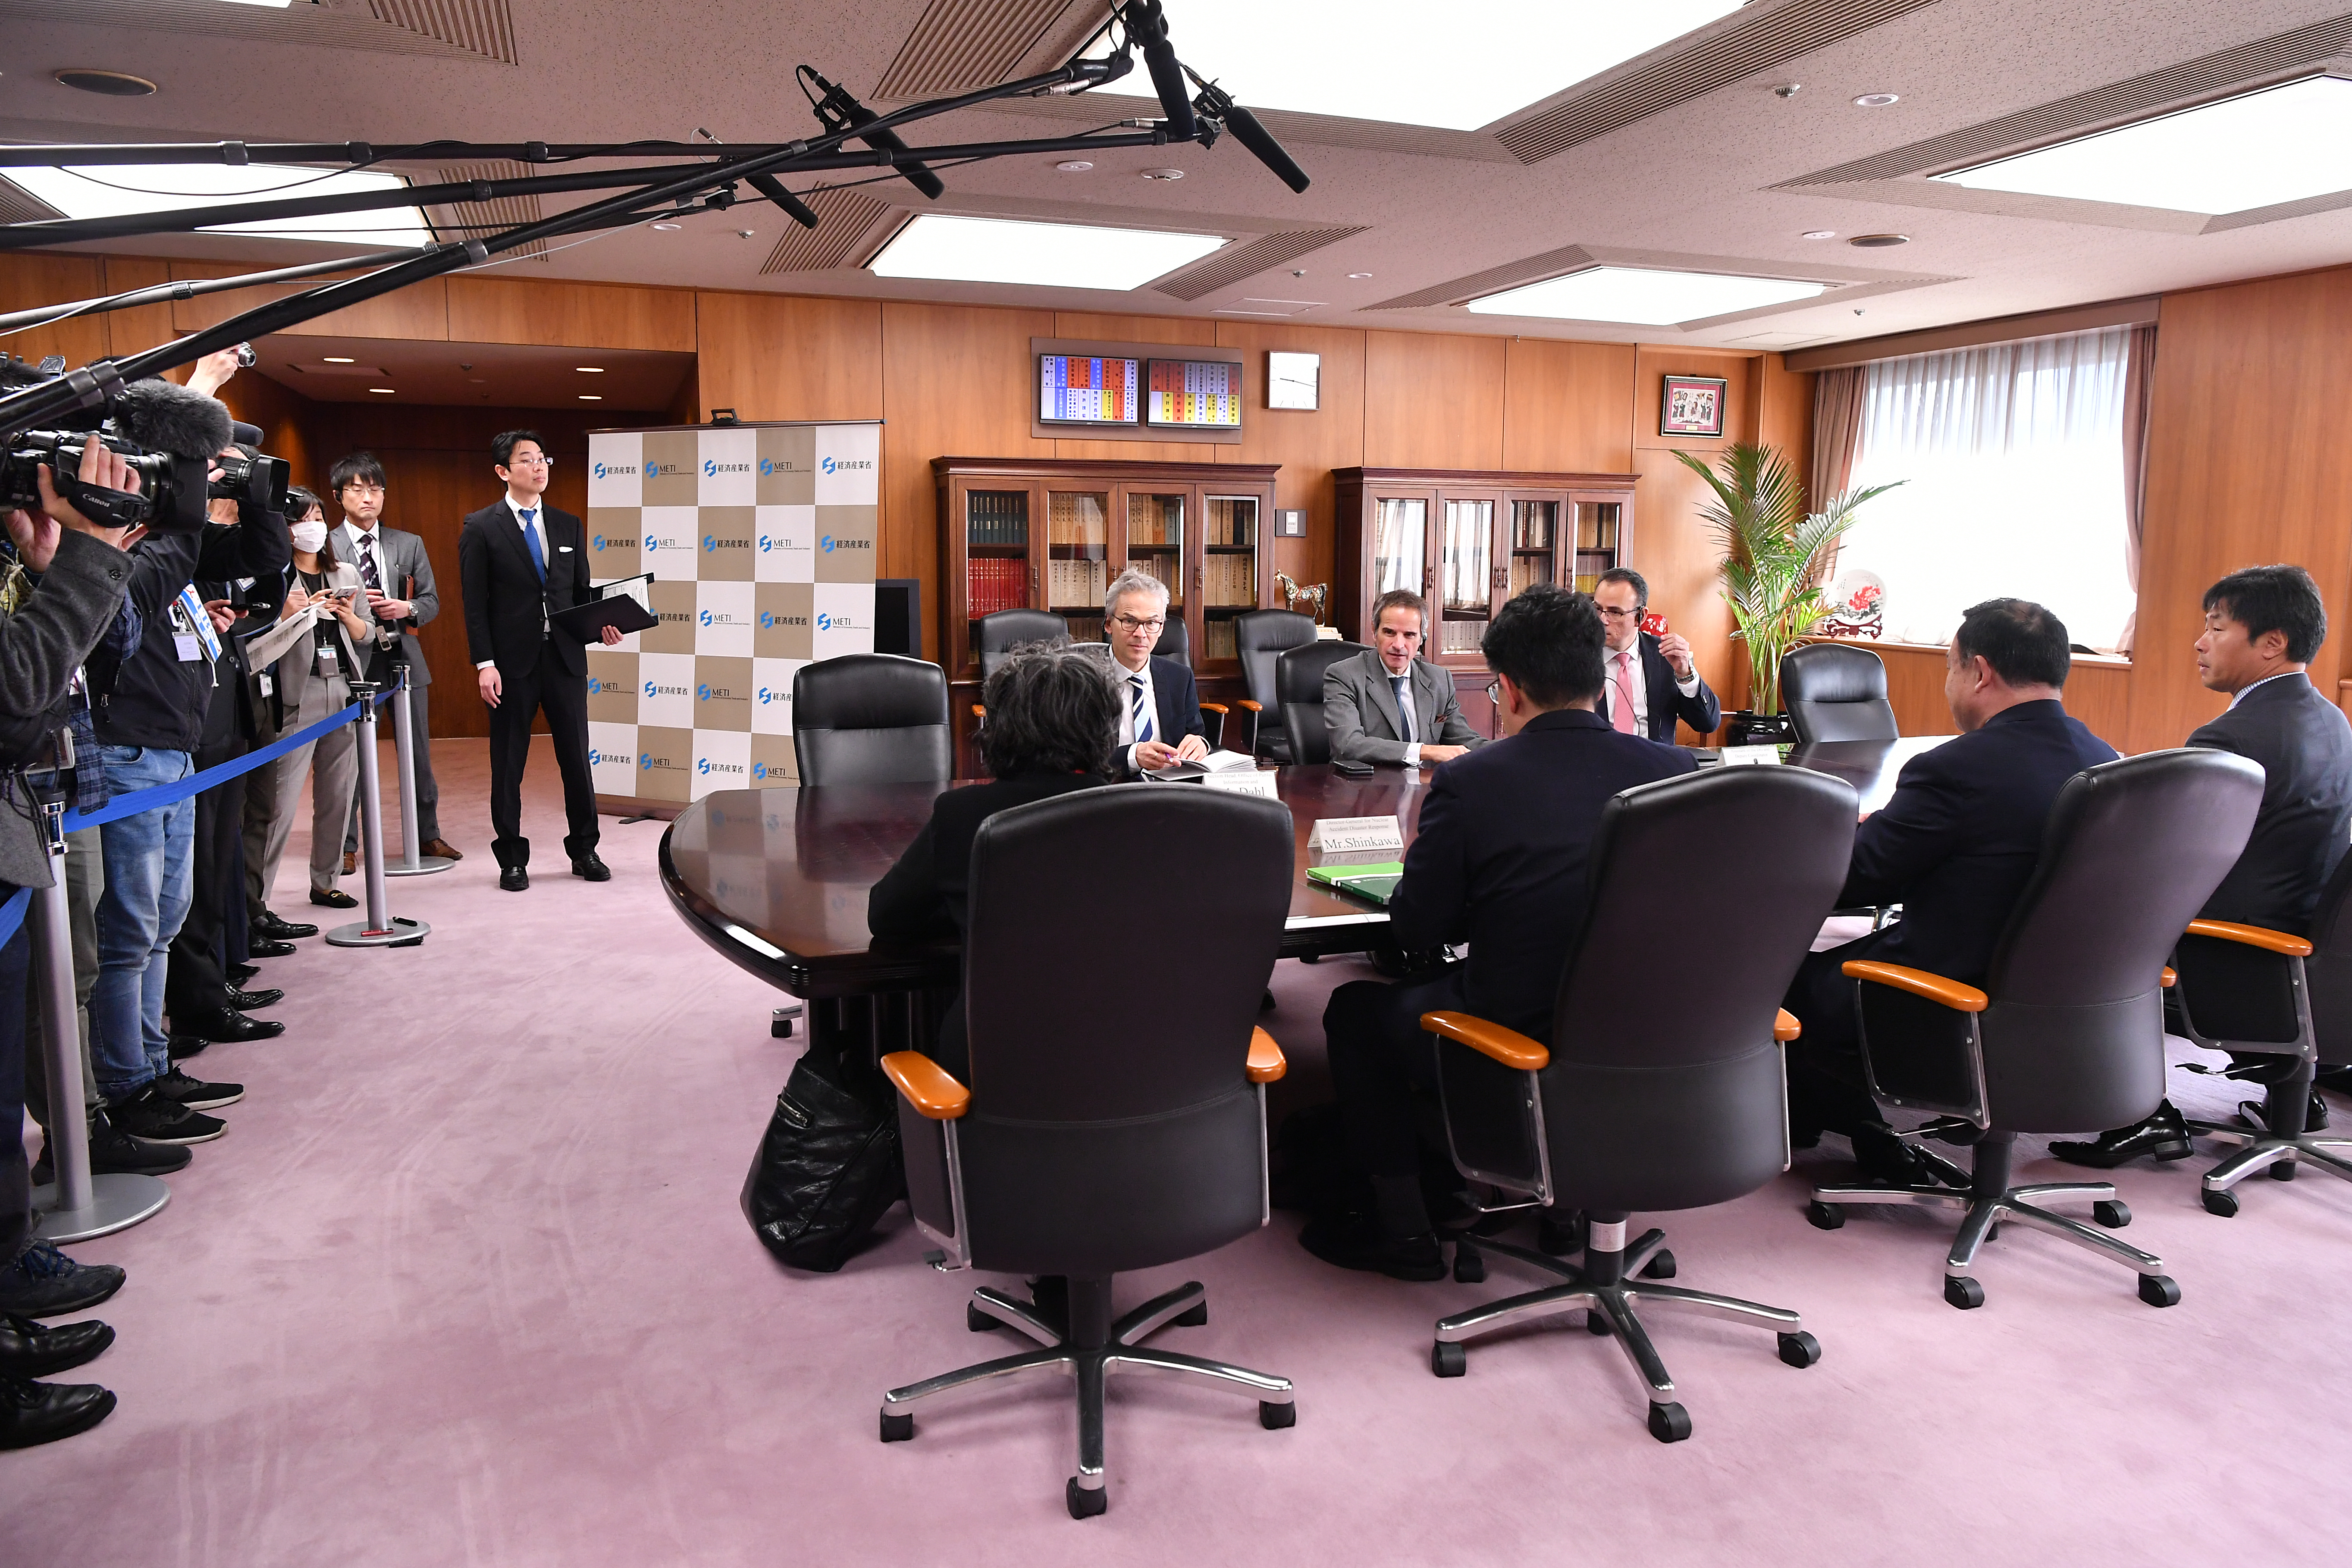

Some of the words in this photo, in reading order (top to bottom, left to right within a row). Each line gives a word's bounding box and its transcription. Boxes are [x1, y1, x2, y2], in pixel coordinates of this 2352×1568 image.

[718, 464, 750, 472] 経済産業省
[838, 461, 872, 470] 経済産業省
[82, 493, 110, 508] Canon
[837, 540, 870, 549] 経済産業省
[197, 598, 216, 642] TBS
[660, 613, 690, 621] 経済産業省
[775, 617, 807, 625] 経済産業省
[658, 686, 687, 695] 経済産業省
[773, 693, 792, 701] 経済産
[602, 755, 630, 764] 経済産業省
[712, 763, 743, 773] 経済産業省
[768, 768, 785, 776] METI
[1324, 837, 1400, 849] Mr.Shinkawa
